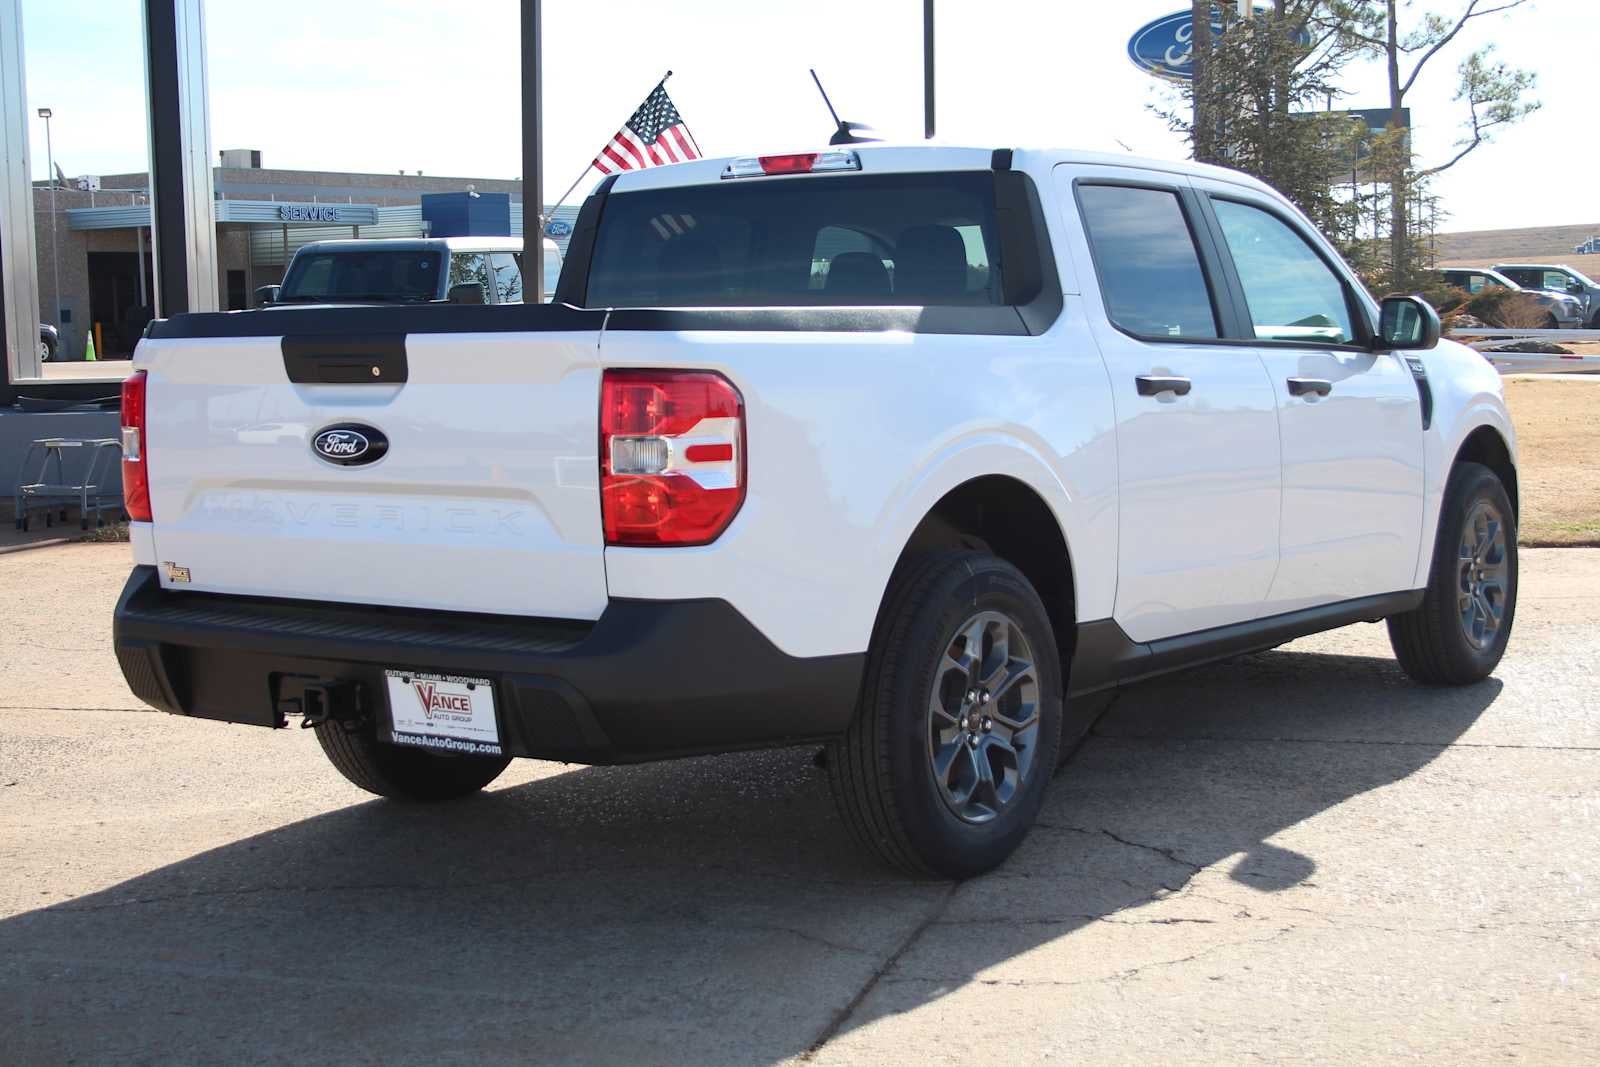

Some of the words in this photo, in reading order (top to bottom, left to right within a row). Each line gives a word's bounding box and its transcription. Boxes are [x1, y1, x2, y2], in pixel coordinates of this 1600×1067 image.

[280, 205, 341, 222] SERVICE
[324, 433, 358, 453] Ford
[420, 673, 442, 681] MIAMI
[446, 675, 491, 686] WOODWARD
[414, 682, 471, 717] VANCE
[452, 715, 473, 723] GROUP
[391, 730, 502, 754] VanceAutoGroup.com
